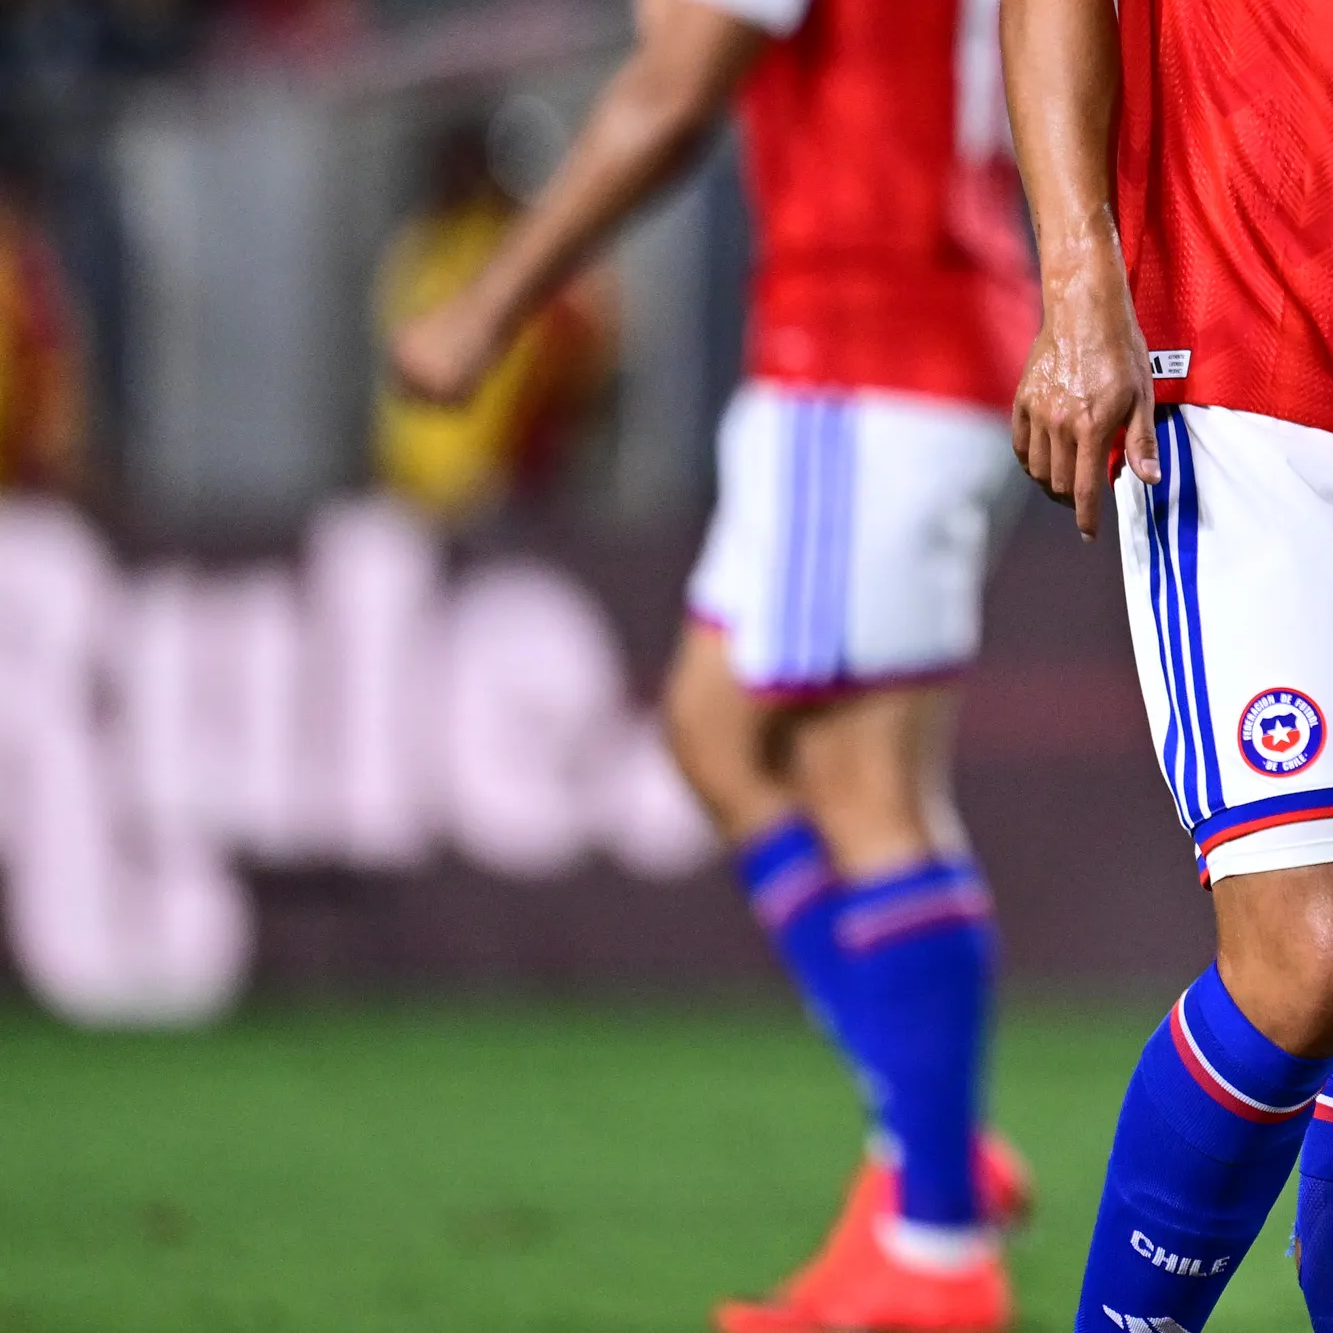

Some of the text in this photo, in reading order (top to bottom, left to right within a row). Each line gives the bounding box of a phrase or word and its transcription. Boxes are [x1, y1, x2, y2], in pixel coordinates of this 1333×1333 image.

[1243, 693, 1319, 741] FEDERACION DE FUTBOL
[1265, 754, 1307, 771] DE CHILE
[1130, 1230, 1230, 1277] CHILE
